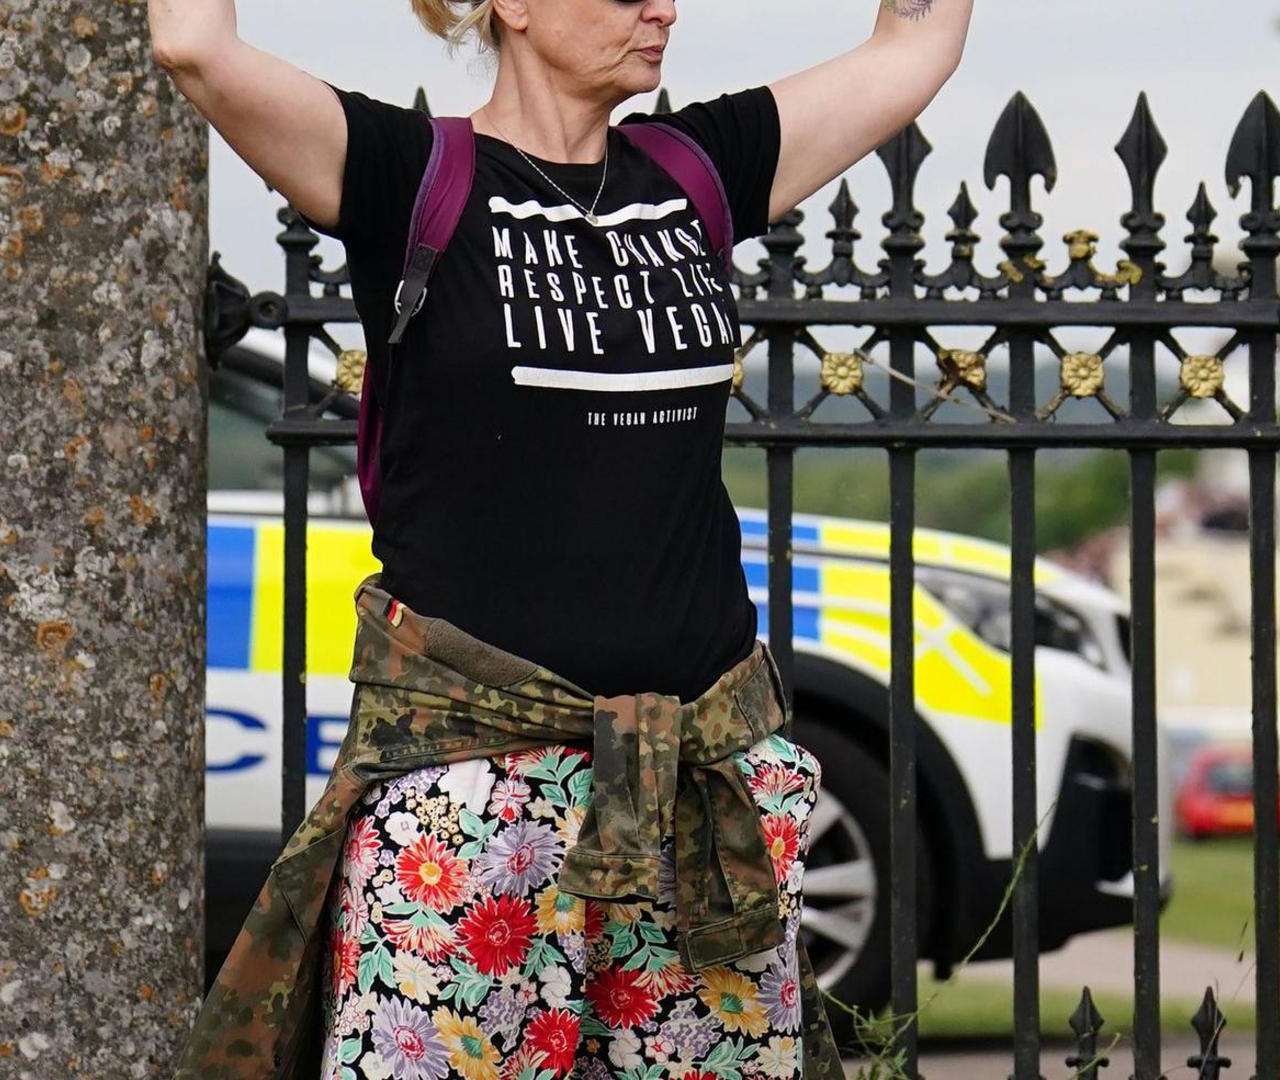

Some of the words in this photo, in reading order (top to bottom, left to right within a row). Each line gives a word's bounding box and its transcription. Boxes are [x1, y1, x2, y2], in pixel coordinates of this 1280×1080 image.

[492, 226, 583, 269] MAKE
[498, 265, 655, 309] RESPECT
[504, 304, 605, 354] LIVE
[588, 412, 606, 426] THE
[613, 412, 645, 426] VEGAN
[652, 406, 698, 424] ACTIVIST
